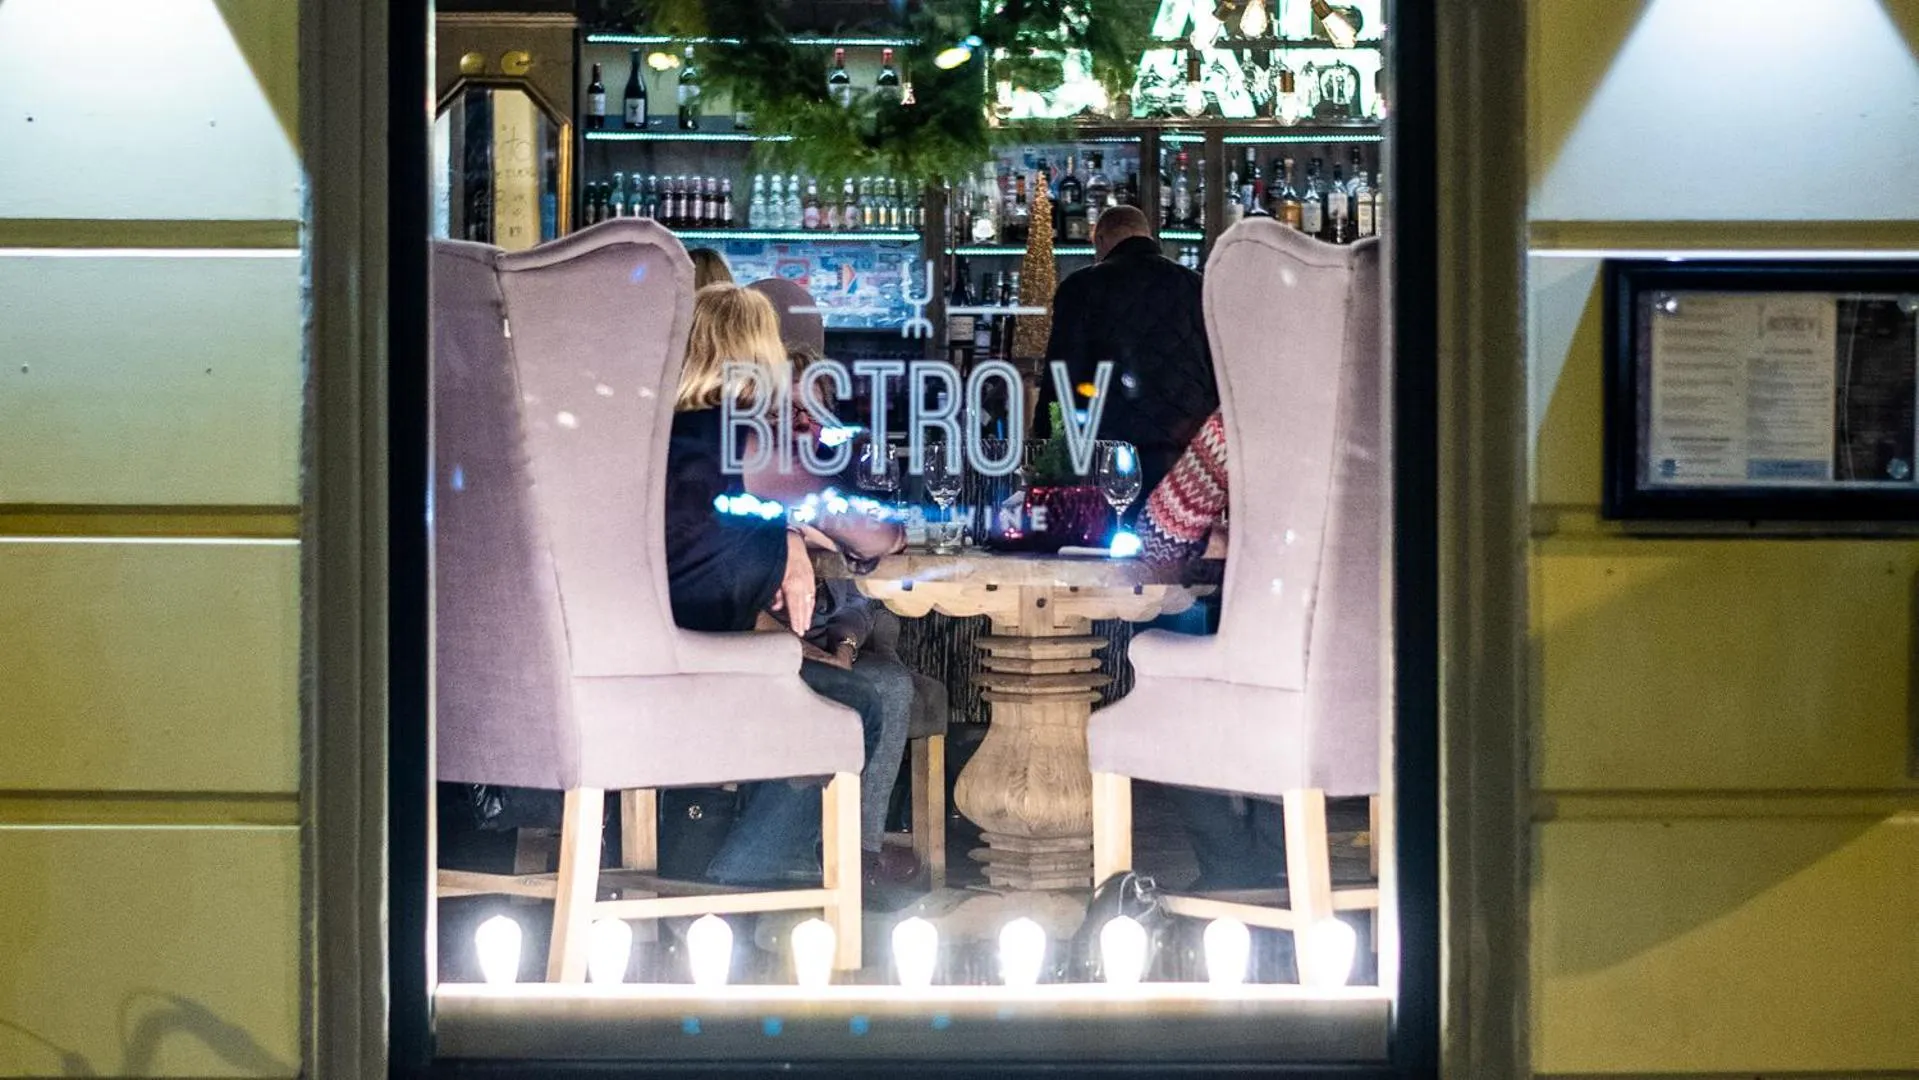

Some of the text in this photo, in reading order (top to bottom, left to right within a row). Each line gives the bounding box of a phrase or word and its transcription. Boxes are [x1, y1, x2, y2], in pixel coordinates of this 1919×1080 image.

[720, 359, 1115, 477] BISTRO V
[951, 505, 1048, 531] WINE
